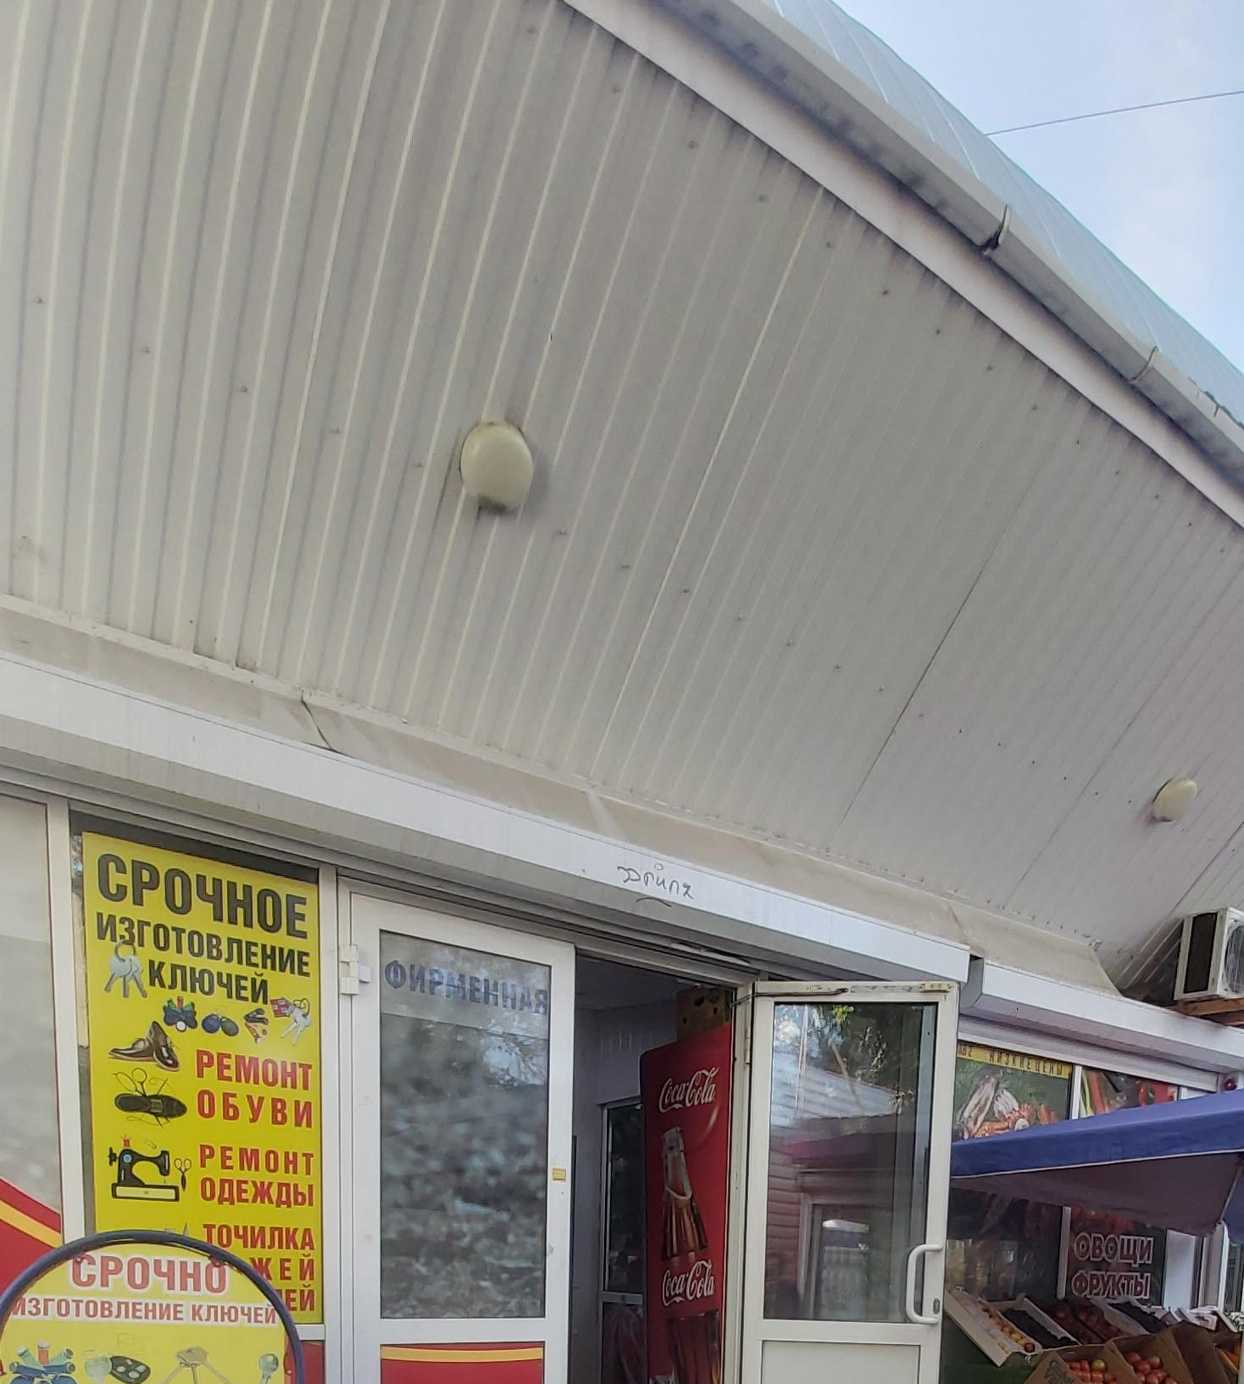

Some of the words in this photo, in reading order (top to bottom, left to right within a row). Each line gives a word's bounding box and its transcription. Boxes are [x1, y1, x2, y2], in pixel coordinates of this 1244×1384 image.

[97, 853, 308, 939] СРОЧНОЕ
[96, 912, 310, 977] ИЗГОТОВЛЕНИЕ
[149, 959, 270, 1005] КЛЮЧЕЙ
[384, 960, 548, 1015] ФИРМЕННАЯ
[196, 1049, 312, 1091] РЕМОНТ
[659, 1067, 720, 1113] Coca-Cola
[197, 1089, 312, 1128] ОБУВИ
[200, 1144, 314, 1176] РЕМОНТ
[200, 1177, 314, 1208] ОДЕЖДЫ
[203, 1223, 315, 1251] ТОЧИЛКА
[1073, 1232, 1154, 1268] ОВОЩИ
[72, 1254, 227, 1294] СРОЧНО
[663, 1260, 715, 1306] Coca-Cola
[1071, 1270, 1152, 1299] ФРУКТЫ
[11, 1297, 184, 1321] ИЗГОТОВЛЕНИЕ
[191, 1302, 277, 1325] КЛЮЧЕЙ
